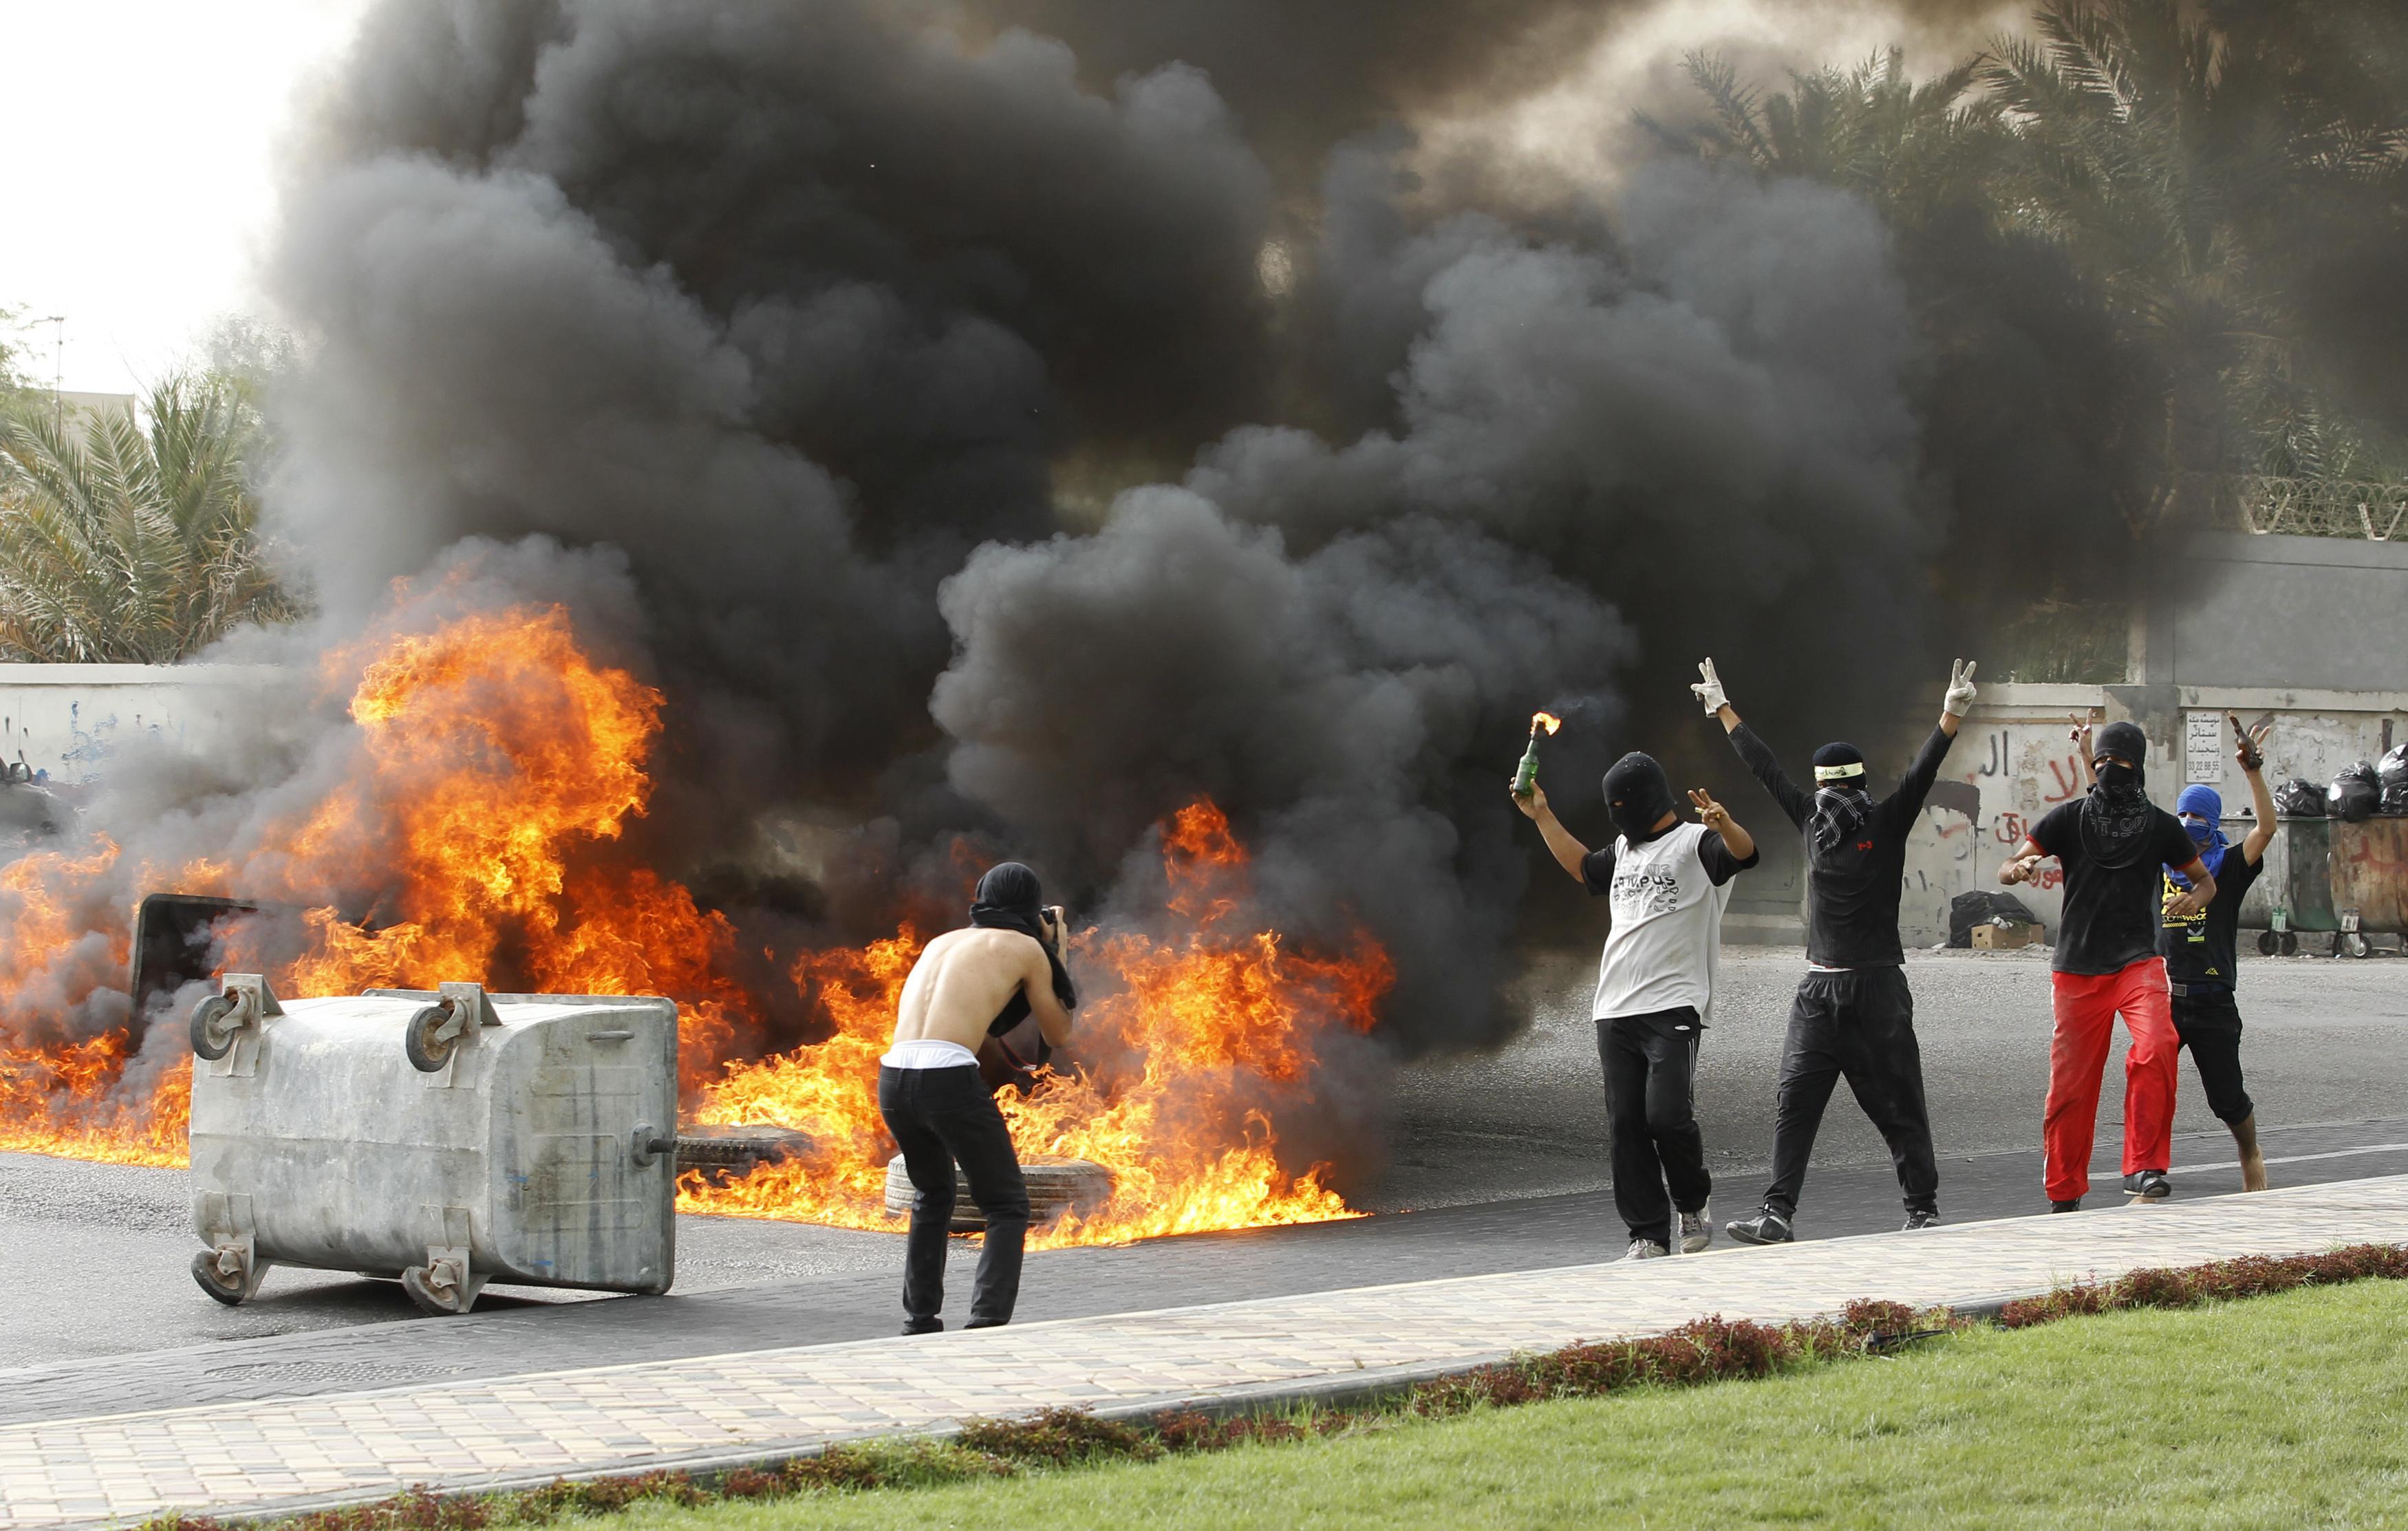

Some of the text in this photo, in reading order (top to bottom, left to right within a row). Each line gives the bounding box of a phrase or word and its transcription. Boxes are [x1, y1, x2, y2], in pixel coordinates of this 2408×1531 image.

[2189, 727, 2217, 740] ستائر
[2188, 761, 2219, 771] 33 22 88 55
